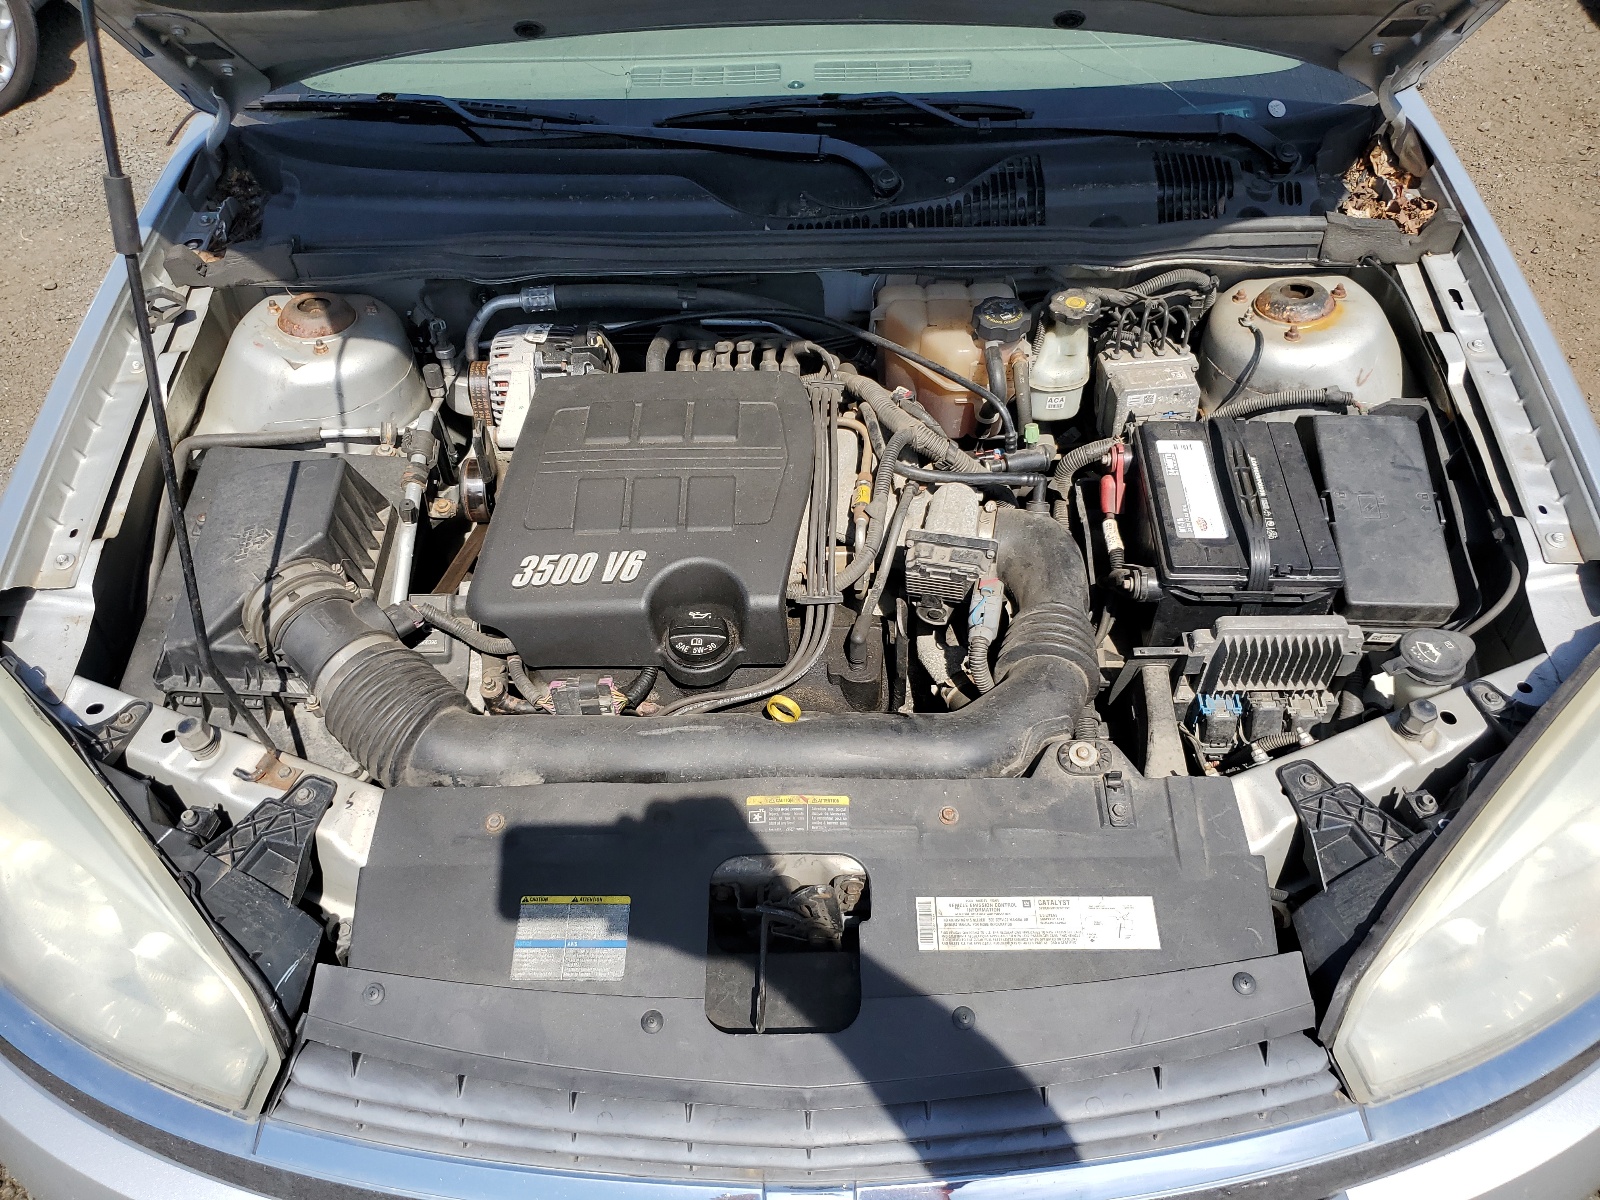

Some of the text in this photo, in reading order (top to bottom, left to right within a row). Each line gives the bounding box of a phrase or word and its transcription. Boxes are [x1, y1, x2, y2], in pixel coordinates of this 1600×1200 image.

[511, 550, 647, 589] 3500 V6
[675, 642, 717, 654] SAE 5W-30
